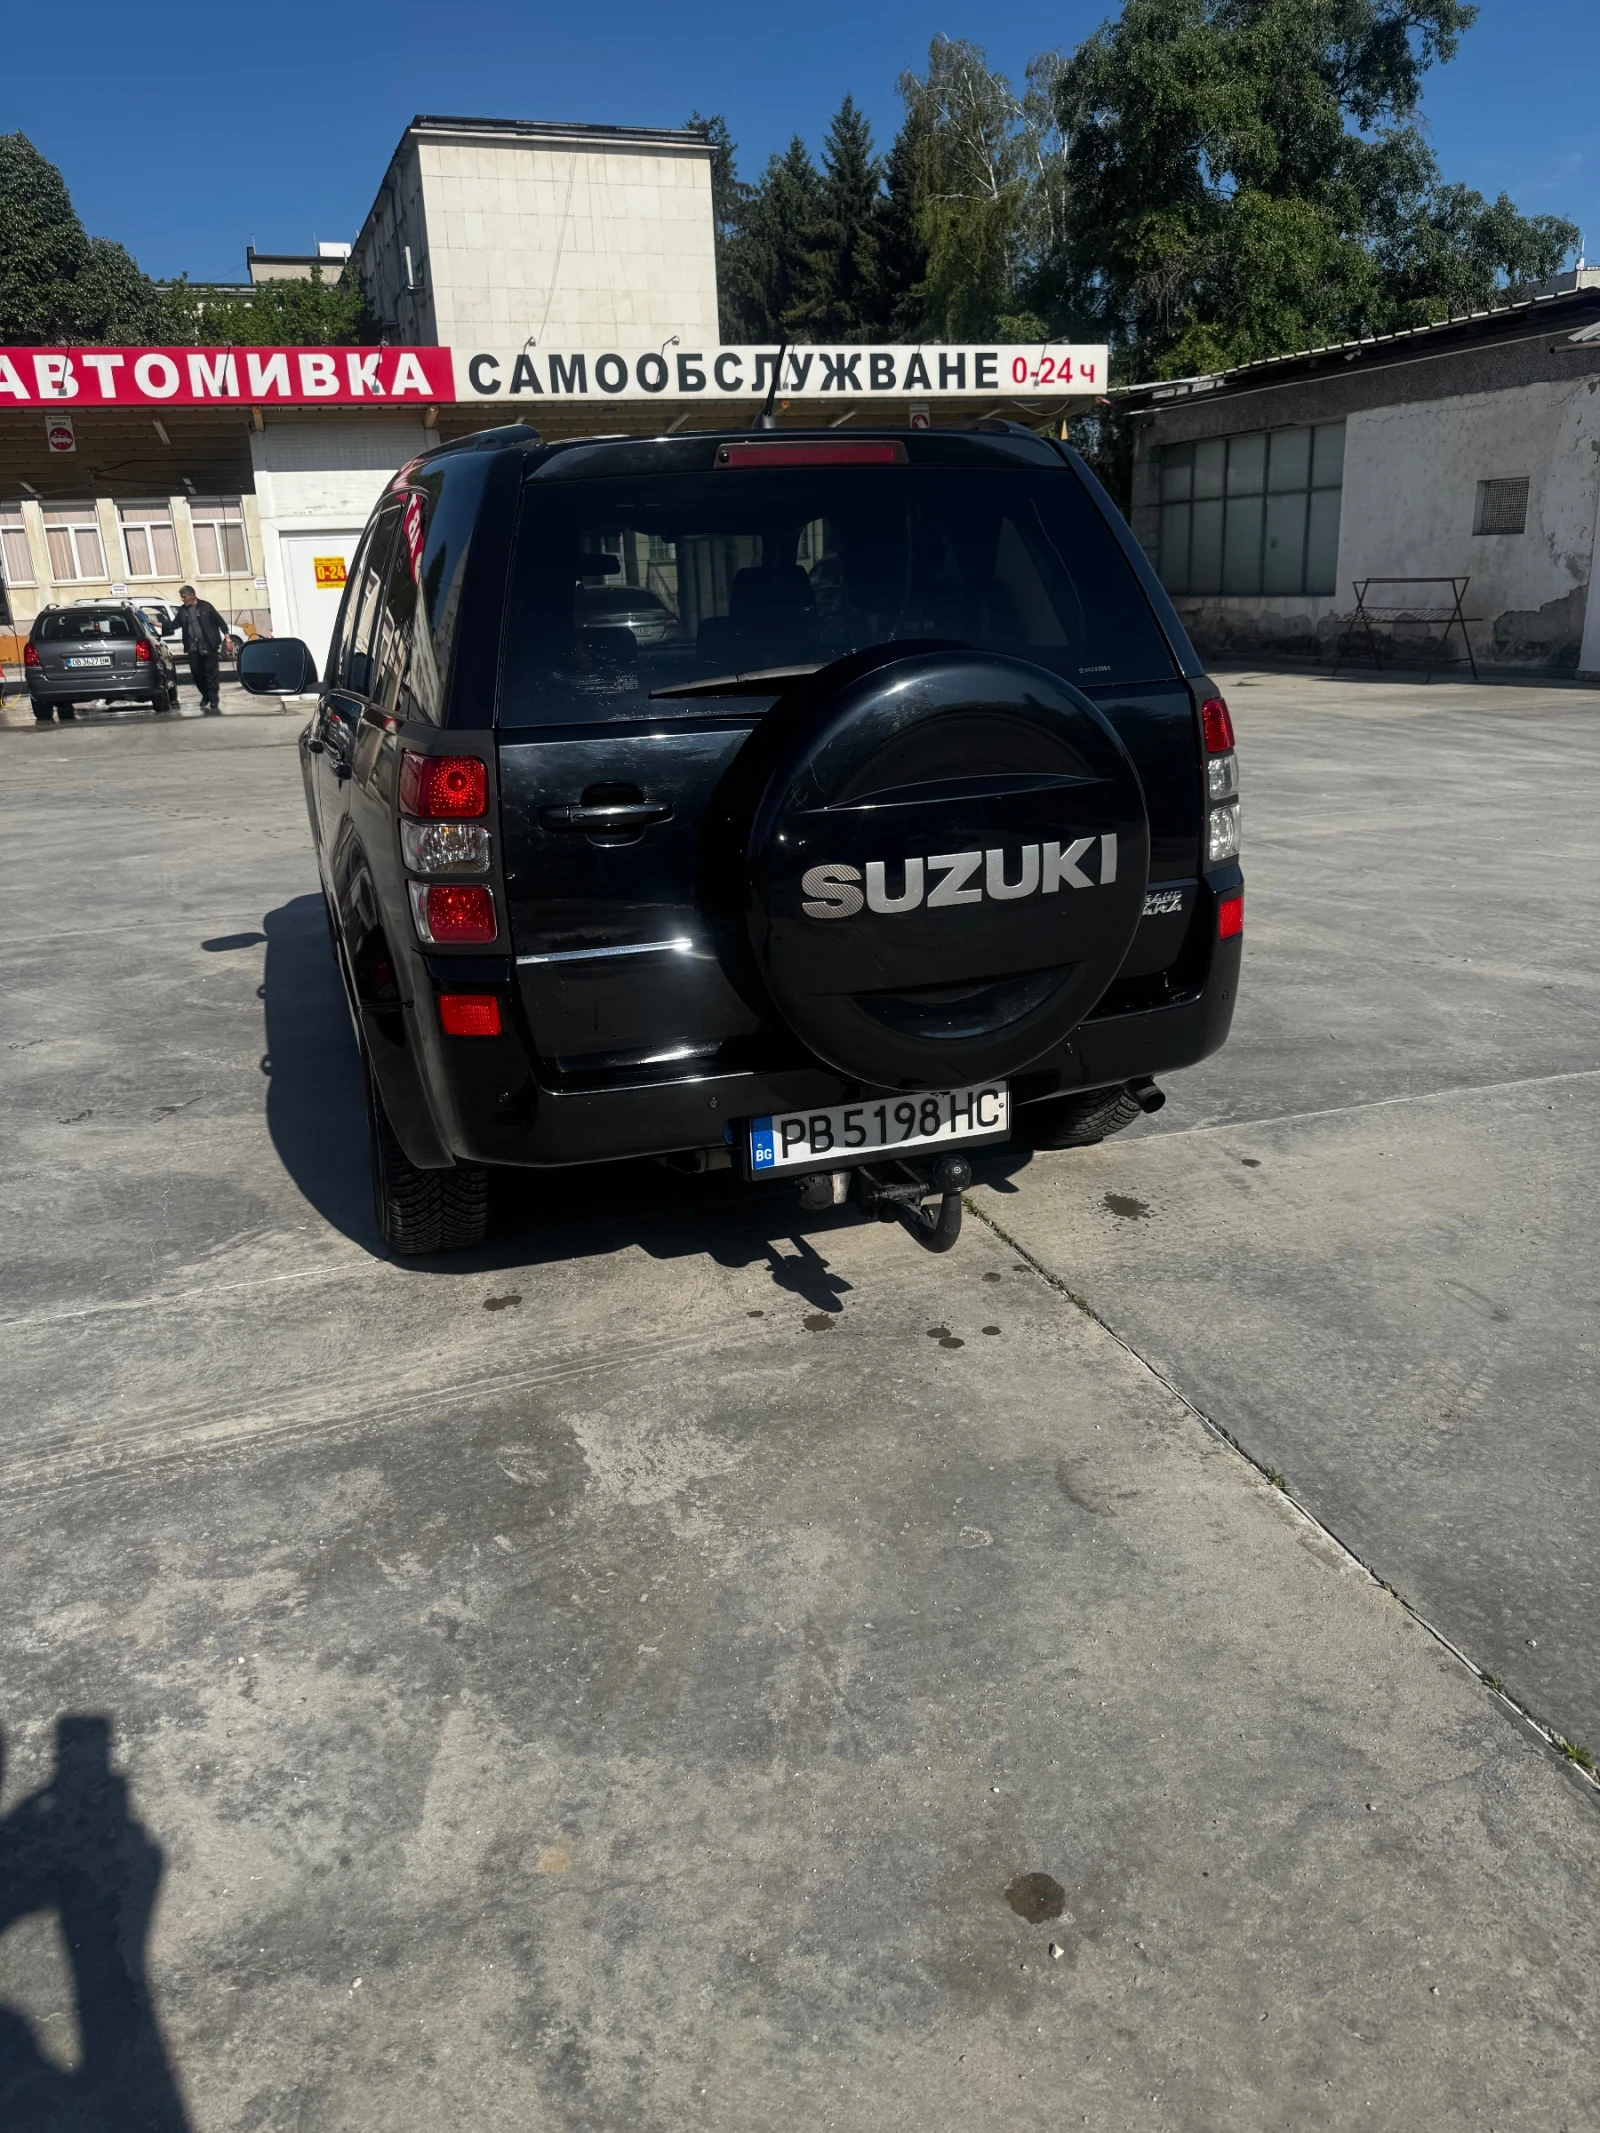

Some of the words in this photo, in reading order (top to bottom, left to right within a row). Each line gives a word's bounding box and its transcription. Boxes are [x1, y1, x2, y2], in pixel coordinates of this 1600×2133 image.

[0, 353, 434, 399] АВТОМИВКА
[468, 352, 999, 394] САМООБСЛУЖВАНЕ
[1012, 357, 1073, 384] 0-24
[316, 566, 346, 580] 0-24
[802, 833, 1118, 919] SUZUKI
[781, 1114, 835, 1160] PB
[843, 1098, 942, 1149] 5198
[949, 1088, 1000, 1133] HC
[755, 1148, 773, 1163] BG
